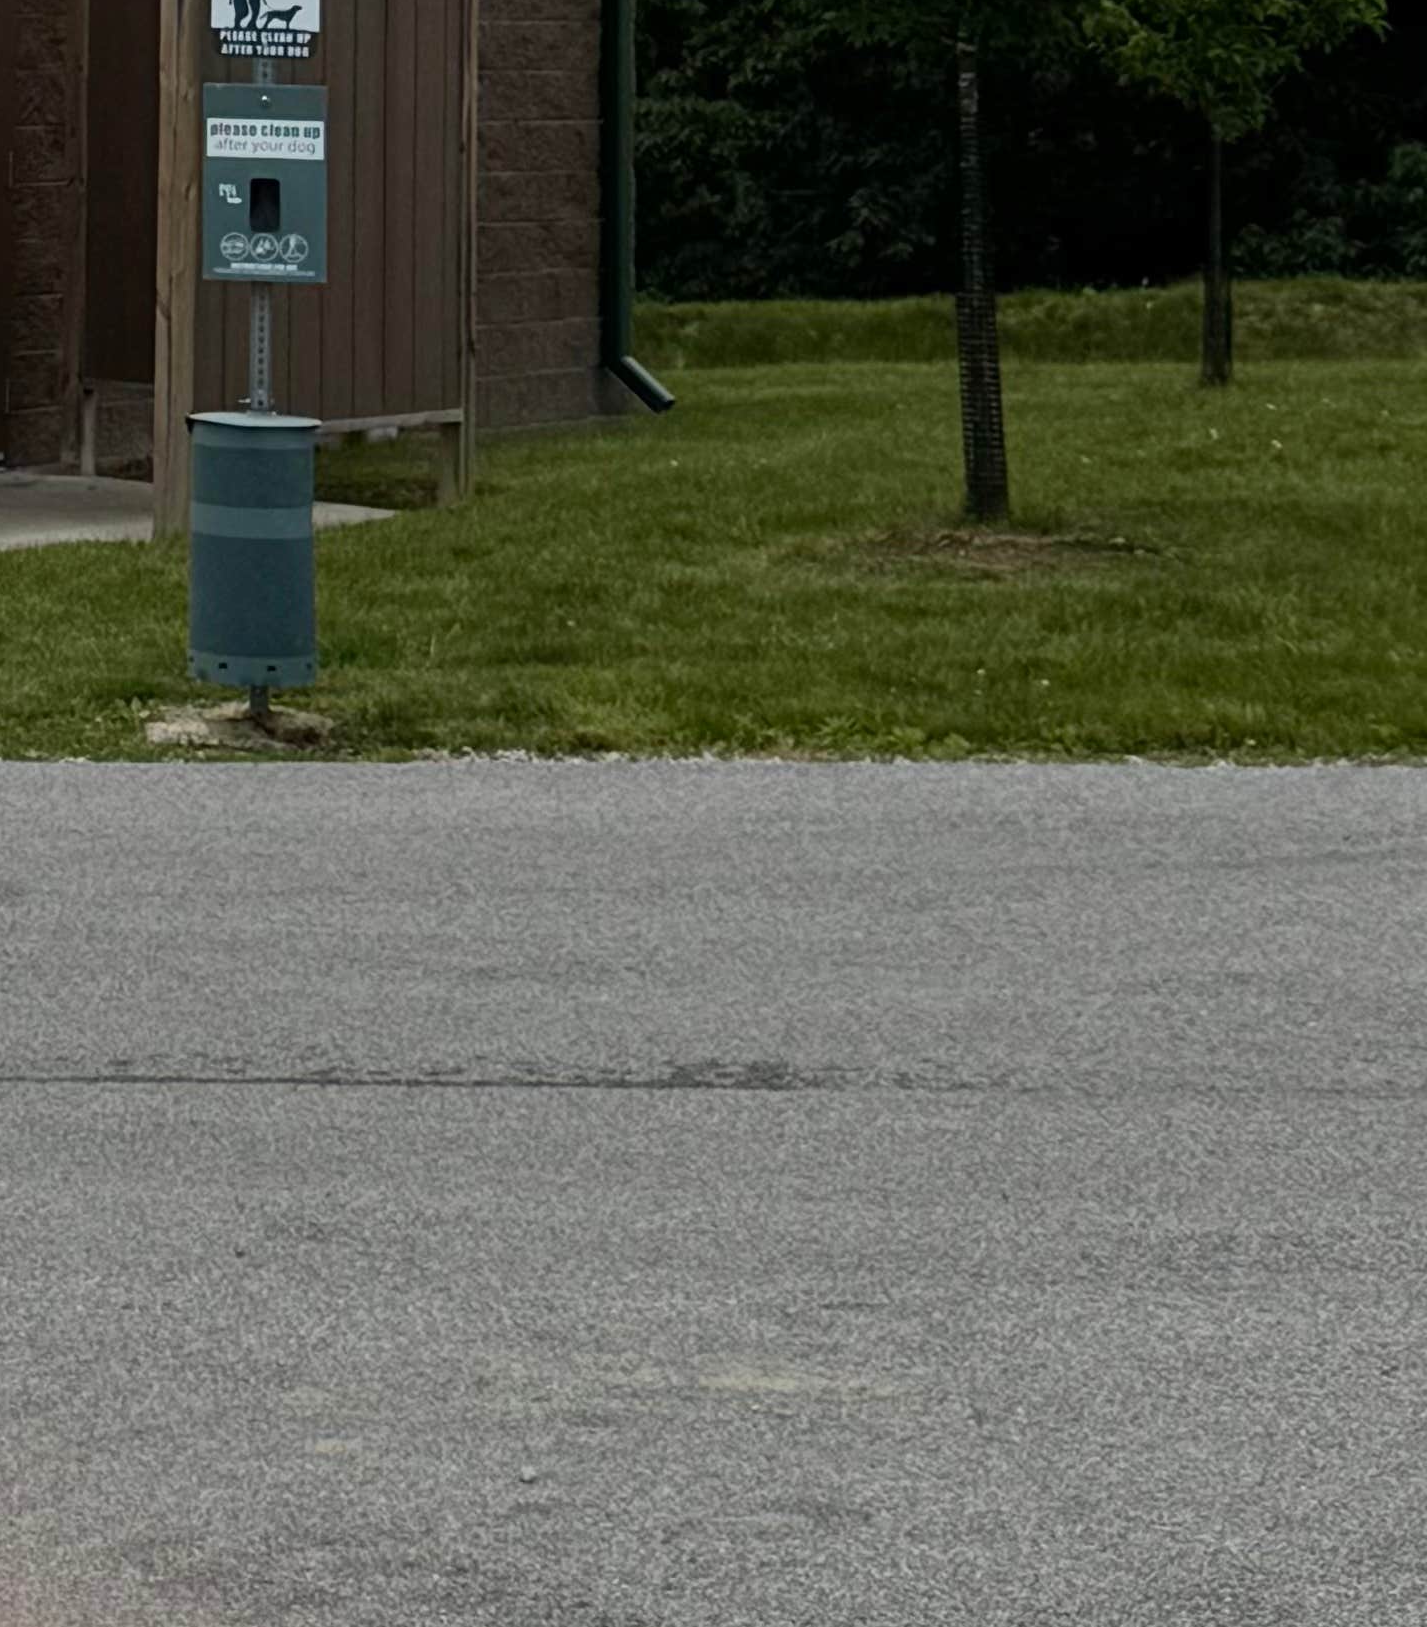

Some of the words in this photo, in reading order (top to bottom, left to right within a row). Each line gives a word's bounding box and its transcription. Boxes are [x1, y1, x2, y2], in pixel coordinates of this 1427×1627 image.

[210, 123, 257, 137] please
[261, 124, 300, 138] clean
[304, 126, 321, 140] up
[213, 138, 248, 152] after
[250, 140, 284, 154] your
[287, 140, 316, 155] dog
